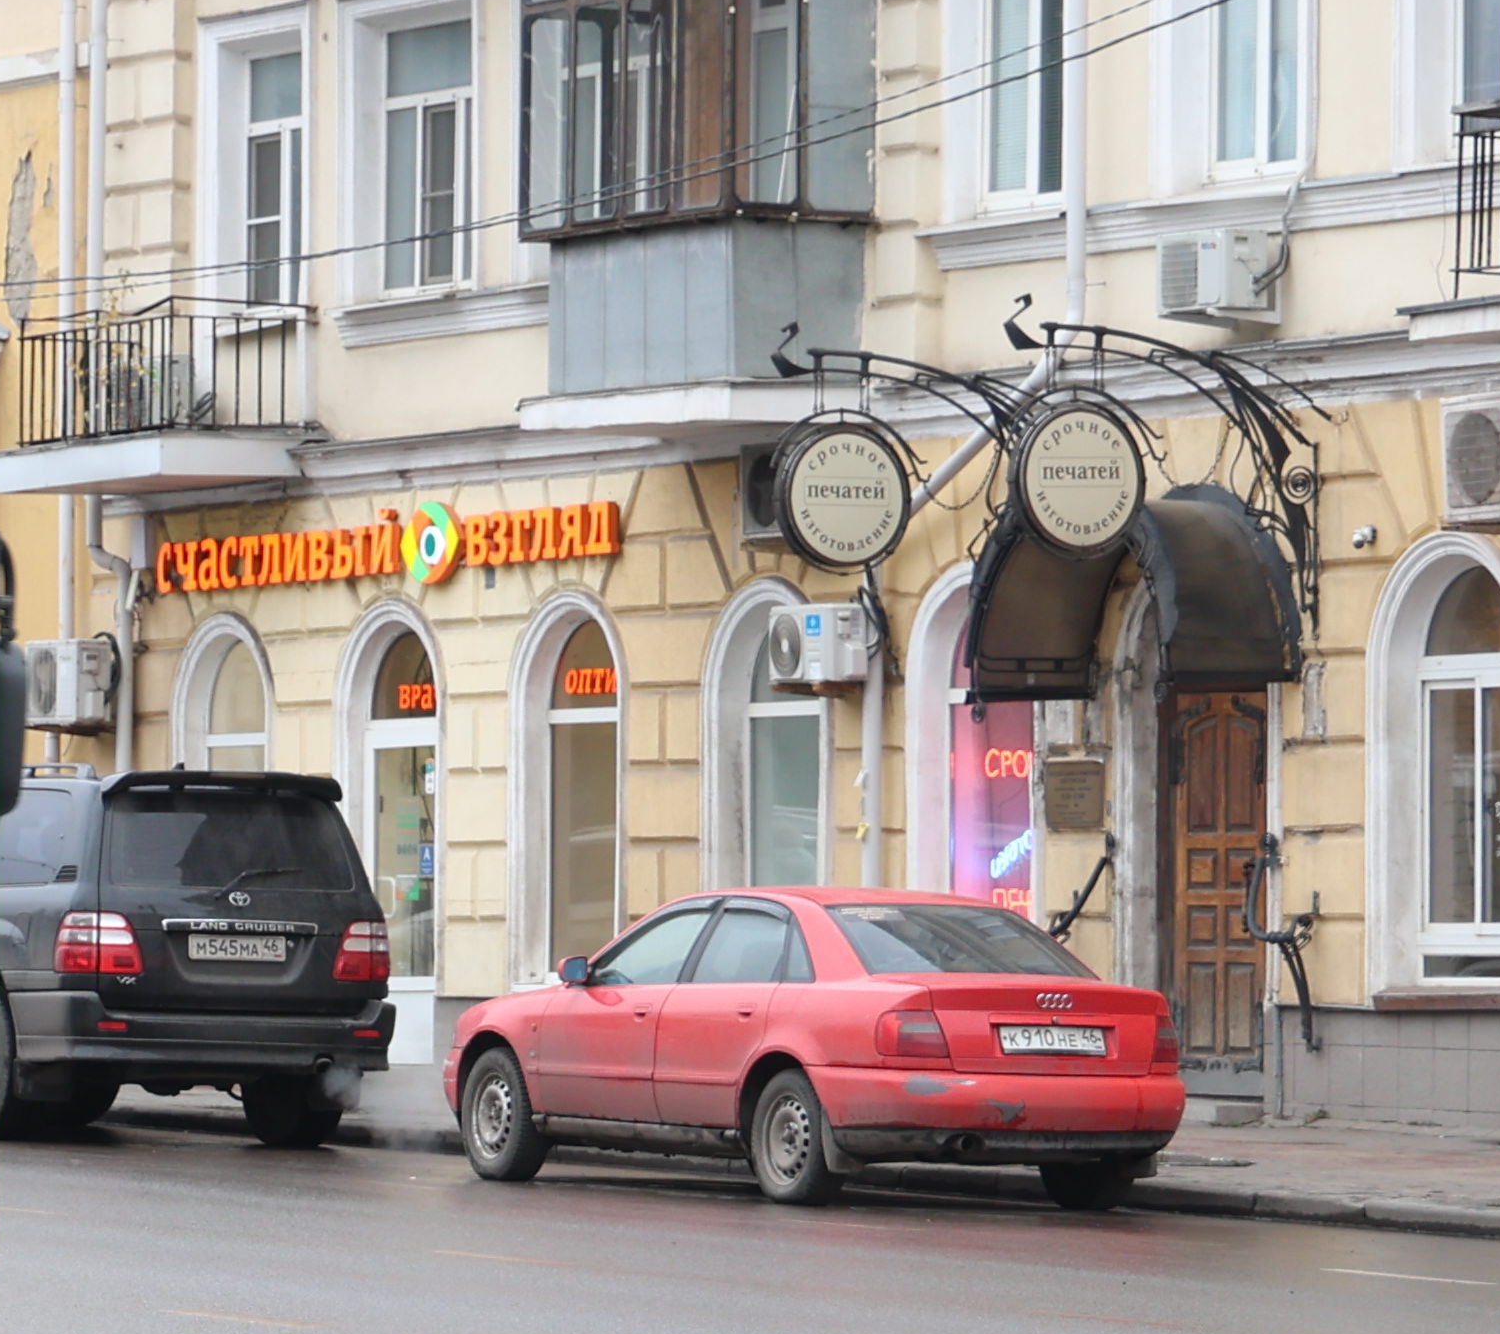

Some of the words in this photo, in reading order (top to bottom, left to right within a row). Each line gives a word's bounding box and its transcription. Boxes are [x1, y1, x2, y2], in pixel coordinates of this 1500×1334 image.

[1042, 420, 1121, 452] срочное
[807, 442, 886, 473] срочное
[1042, 459, 1120, 480] печатей
[807, 479, 885, 500] печатей
[1036, 490, 1129, 535] изготовление
[800, 508, 893, 552] изготовление
[397, 683, 436, 710] вра
[985, 748, 1032, 779] СРО
[190, 922, 228, 930] LAND
[235, 923, 295, 932] CRUISER
[196, 939, 258, 956] М545МА
[263, 940, 279, 953] 46
[117, 975, 136, 985] VX
[1008, 1028, 1078, 1047] К910НЕ
[1082, 1029, 1097, 1044] 46
